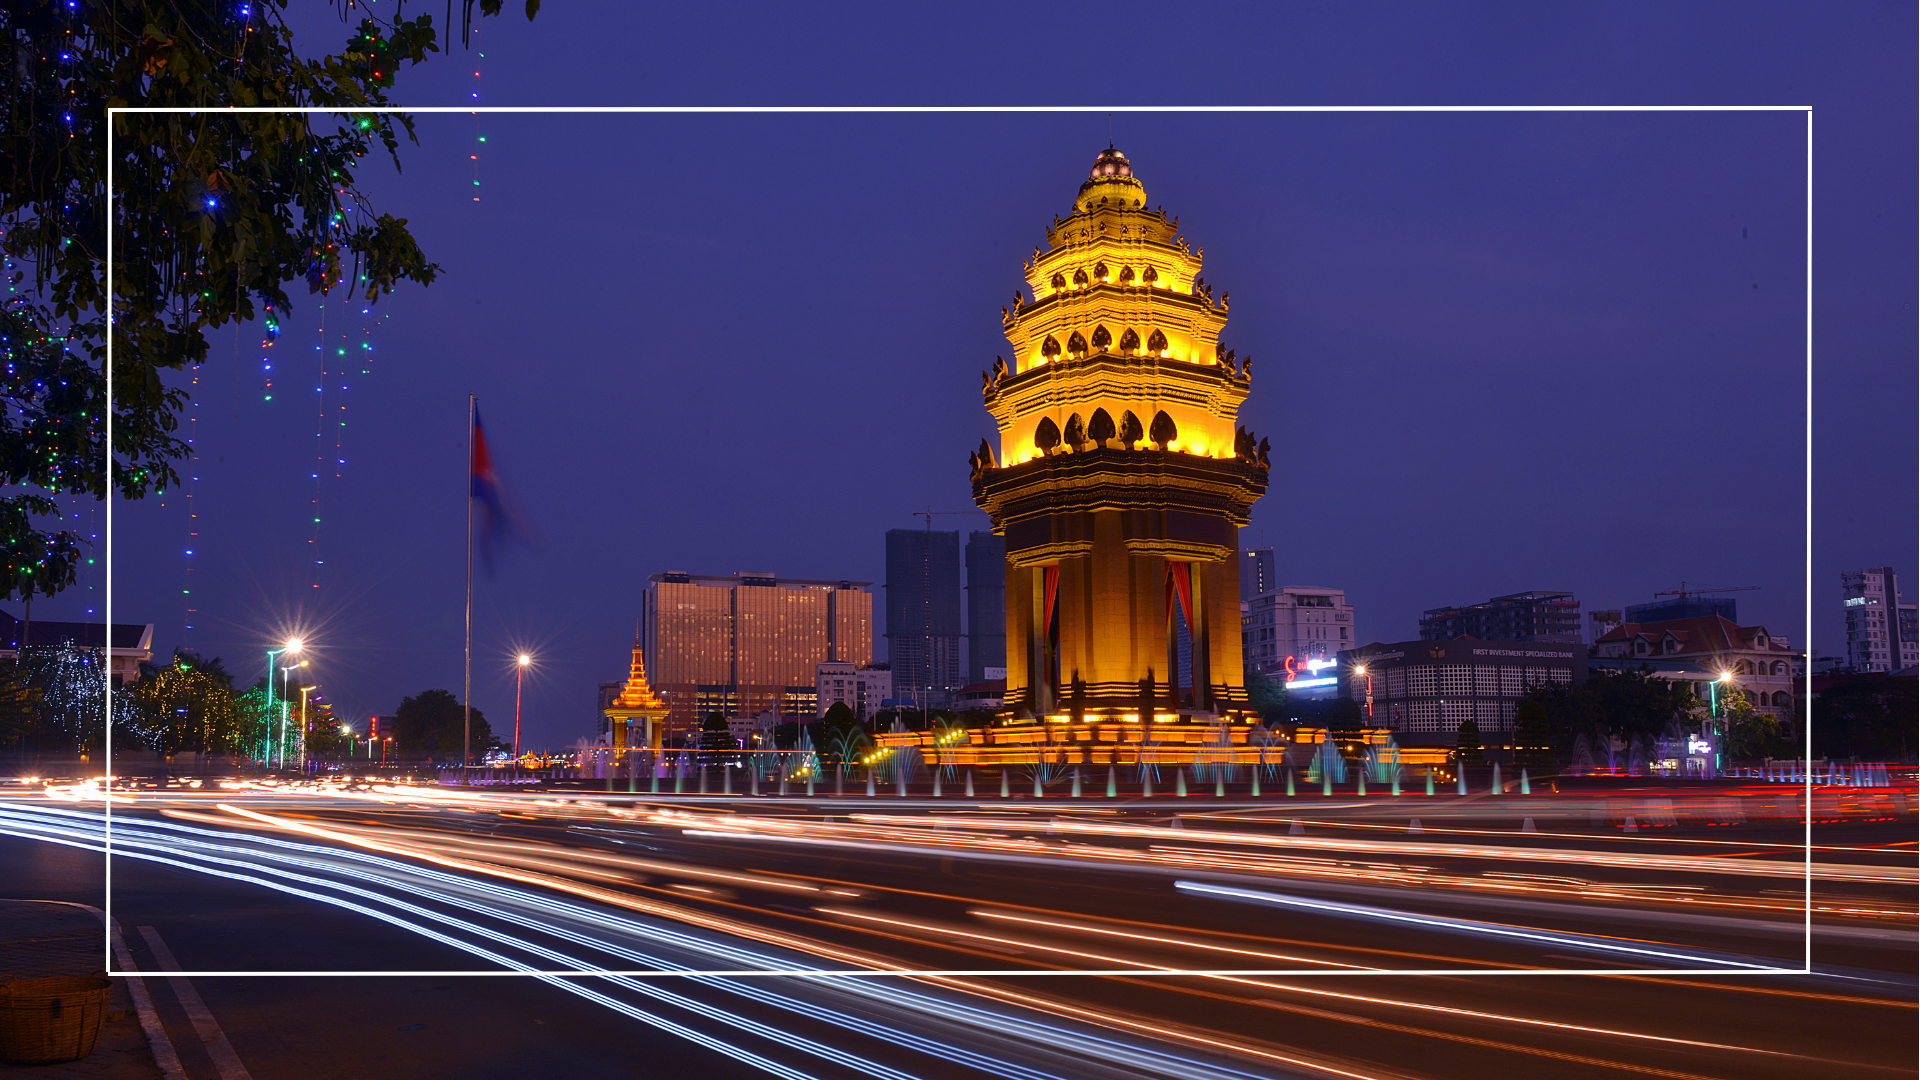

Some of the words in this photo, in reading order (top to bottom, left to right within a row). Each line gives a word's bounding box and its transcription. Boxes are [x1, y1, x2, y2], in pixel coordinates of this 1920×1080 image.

[1473, 648, 1488, 656] FIRST
[1489, 649, 1524, 657] INVESTMENT
[1525, 650, 1558, 658] SPECIALIZED
